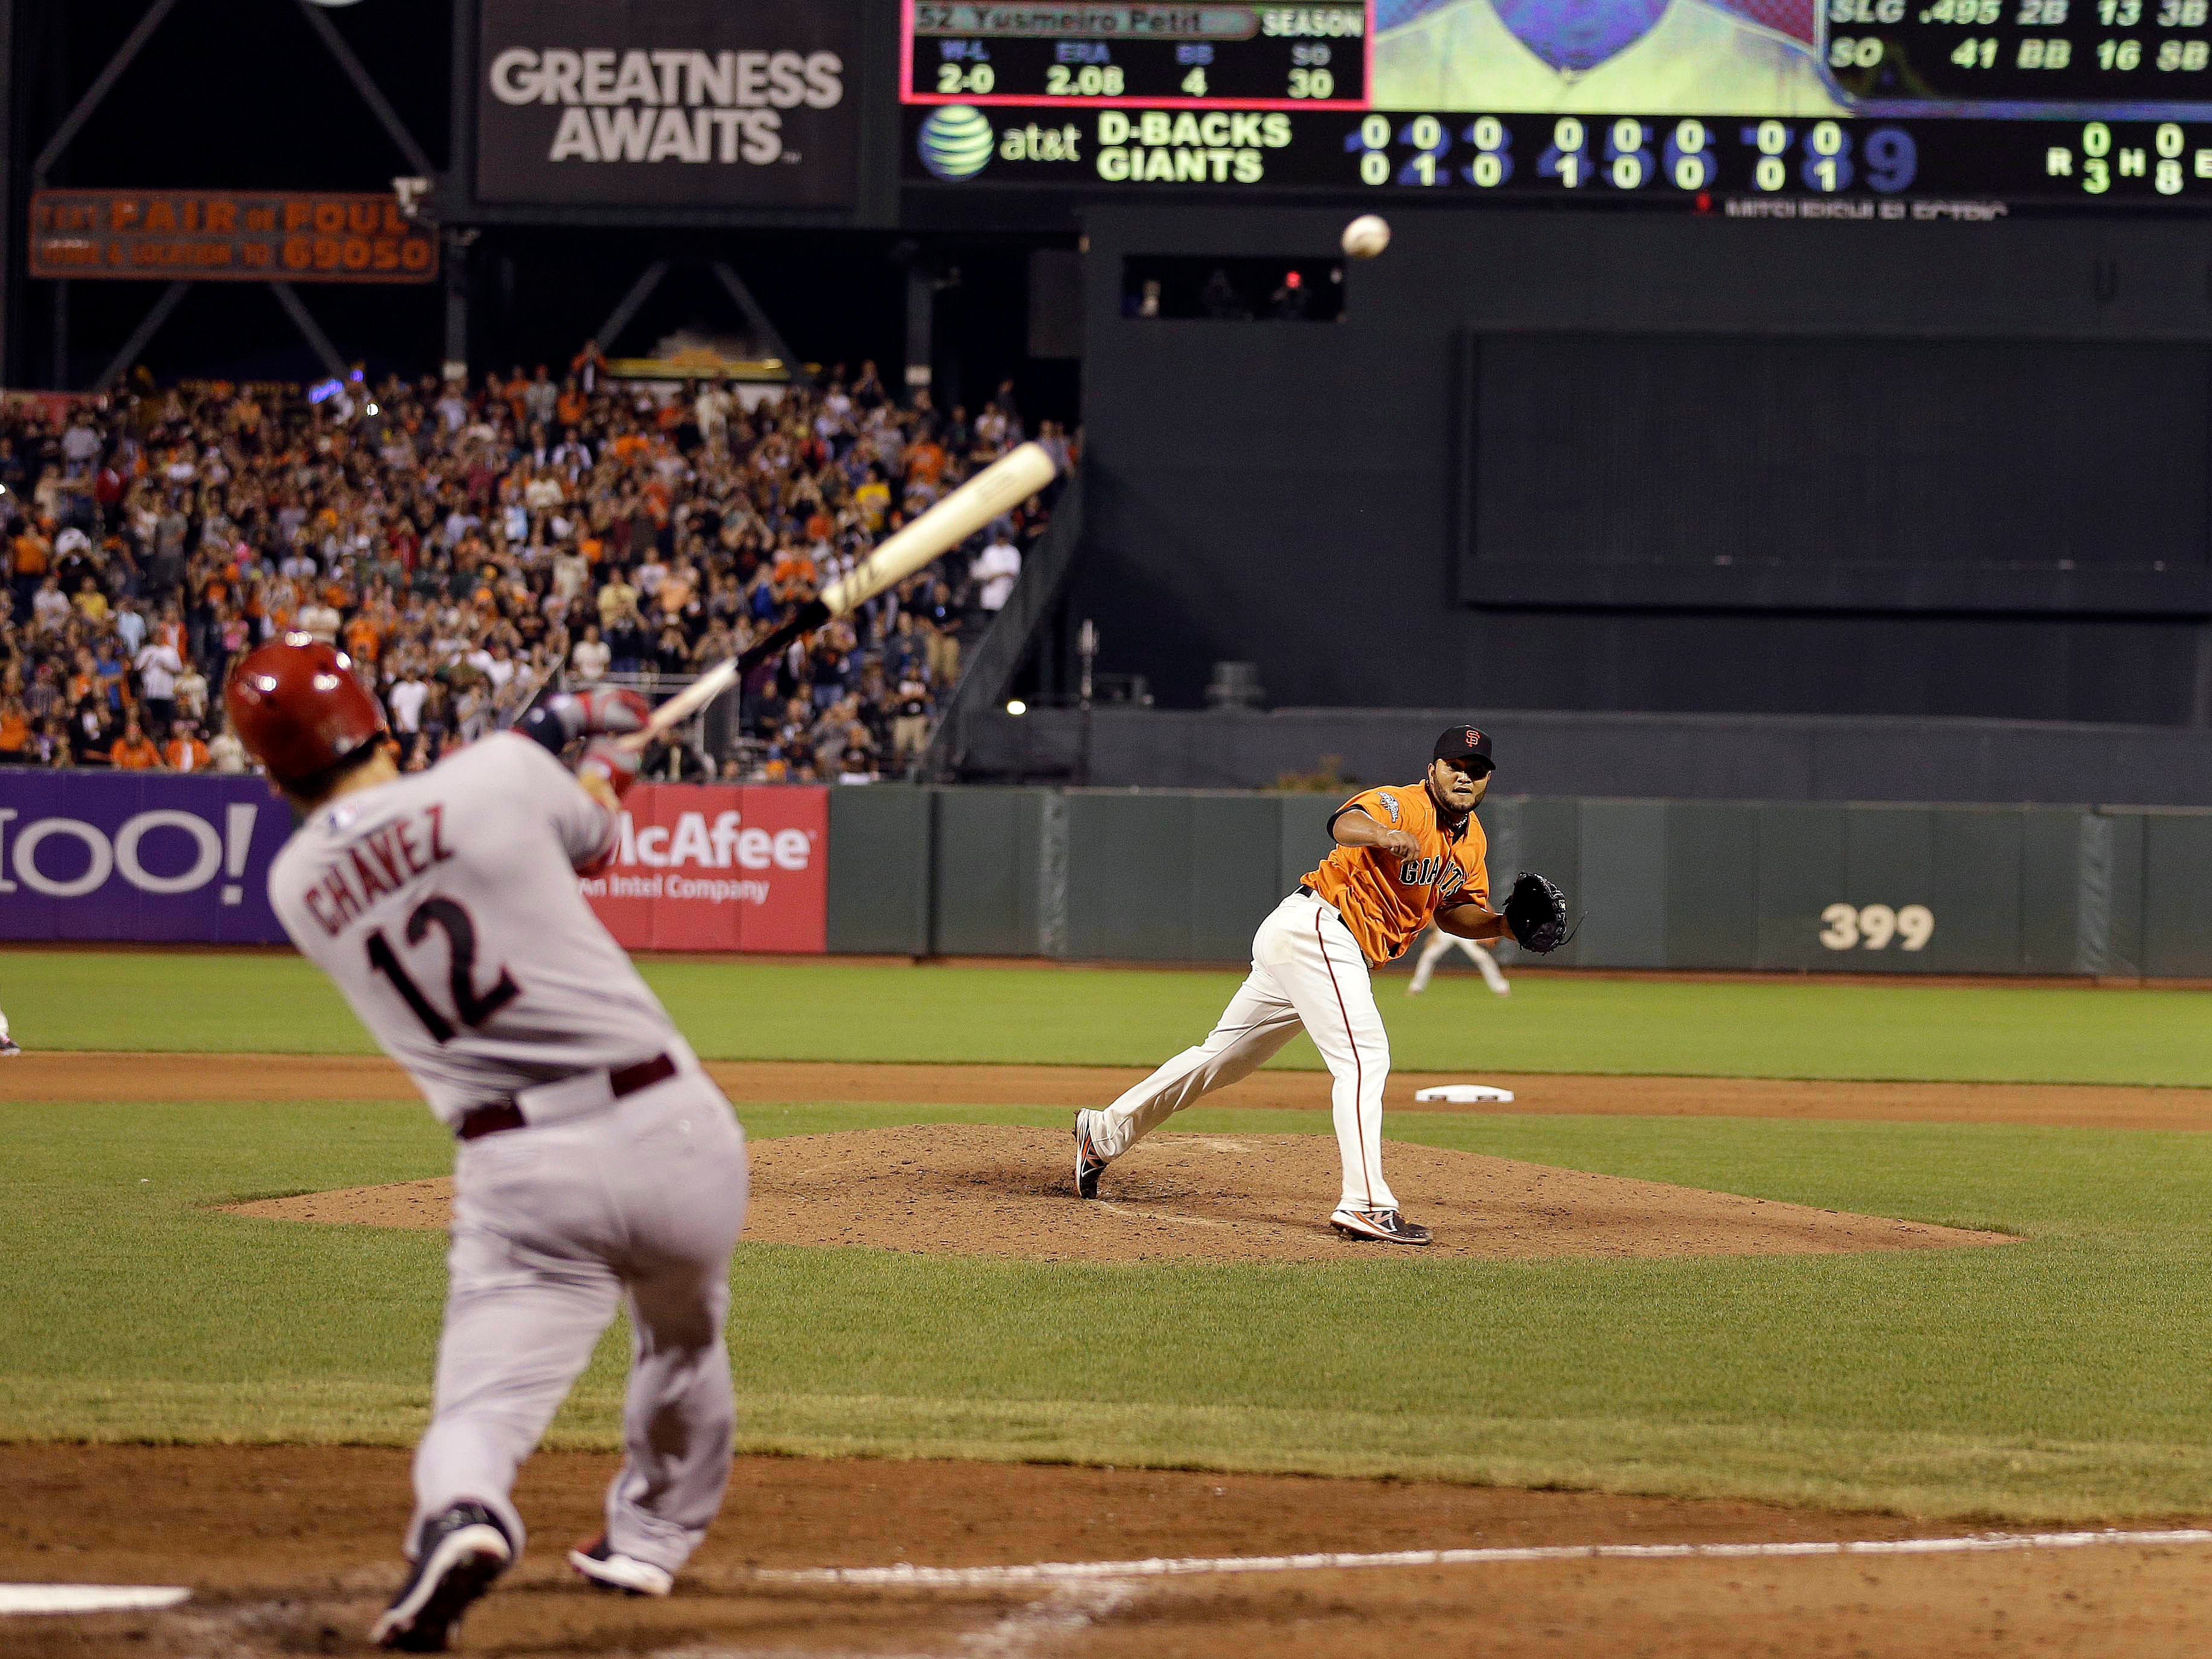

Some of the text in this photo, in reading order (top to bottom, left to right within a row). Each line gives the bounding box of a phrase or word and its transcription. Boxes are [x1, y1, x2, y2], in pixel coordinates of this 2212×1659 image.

[918, 7, 954, 29] 52
[1129, 9, 1201, 32] Petit
[1262, 9, 1364, 37] SEASON
[1829, 0, 2209, 27] SLG .495 2B 13 3B
[1829, 37, 1884, 68] SO
[1951, 37, 1999, 69] 41
[2016, 38, 2073, 69] BB
[2097, 38, 2143, 71] 16
[489, 46, 845, 109] GREATNESS
[936, 63, 1334, 99] 2-0 2.08 4 30
[549, 107, 784, 165] AWAITS
[1000, 123, 1082, 161] at&t
[1098, 110, 2184, 158] D-BACKS 0 0 0 0 0 0 0 0 0 0
[1096, 146, 2184, 195] GIANTS 0 1 0 1 0 0 0 1 3 8
[1863, 124, 1918, 194] 9
[2047, 147, 2073, 176] R
[2118, 147, 2147, 177] H
[111, 201, 238, 233] FAIR
[284, 202, 410, 234] FOUL
[283, 237, 429, 269] 69050
[304, 802, 456, 938] CHAVEZ
[610, 872, 664, 898] Intel
[666, 874, 771, 906] Company
[1819, 903, 1935, 951] 399
[365, 892, 526, 1047] 12
